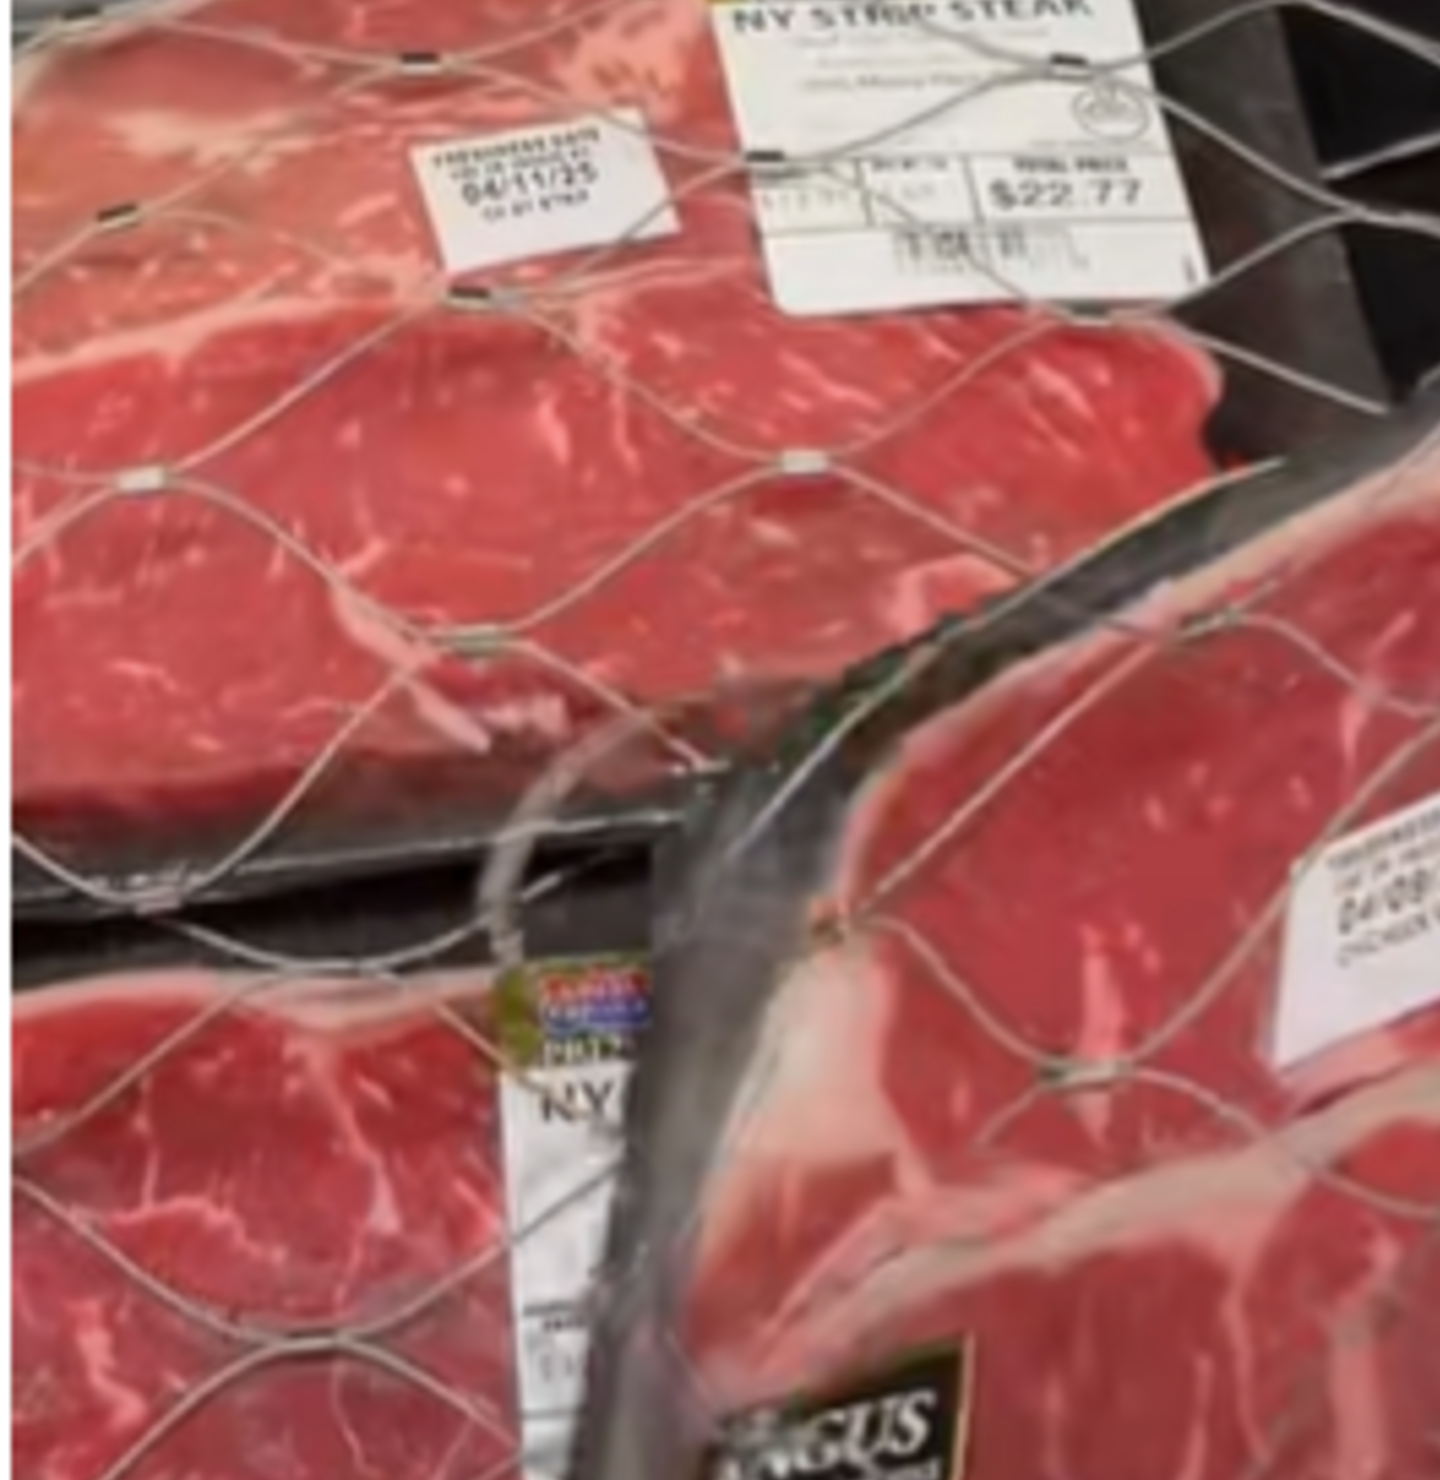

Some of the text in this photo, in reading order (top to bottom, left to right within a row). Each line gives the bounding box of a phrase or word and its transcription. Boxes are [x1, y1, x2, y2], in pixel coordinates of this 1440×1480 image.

[733, 8, 794, 33] NY
[989, 177, 1142, 211] $22.77
[541, 1080, 615, 1122] NY
